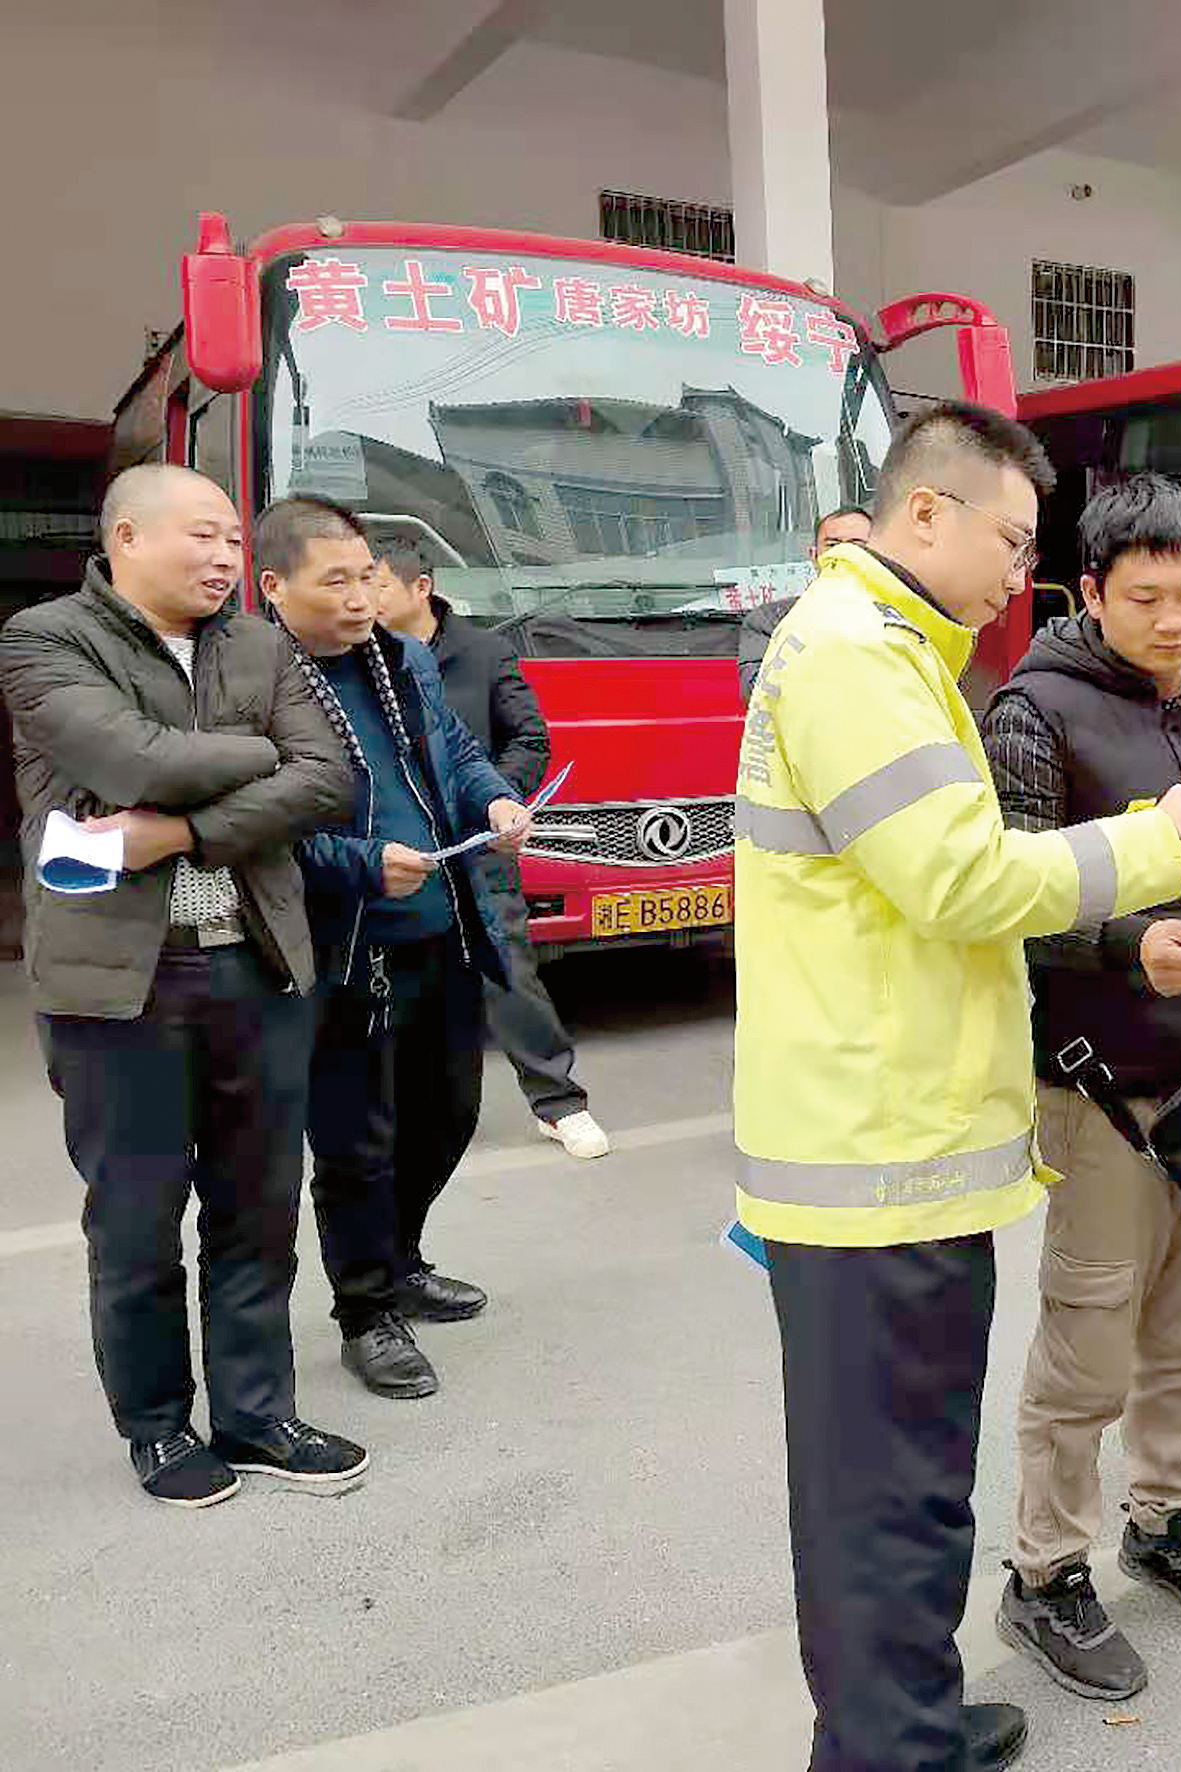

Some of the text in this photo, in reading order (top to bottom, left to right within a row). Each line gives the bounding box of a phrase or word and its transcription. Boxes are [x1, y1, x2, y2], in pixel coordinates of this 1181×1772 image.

[286, 258, 860, 373] 黄土矿 唐家坊 绥宁
